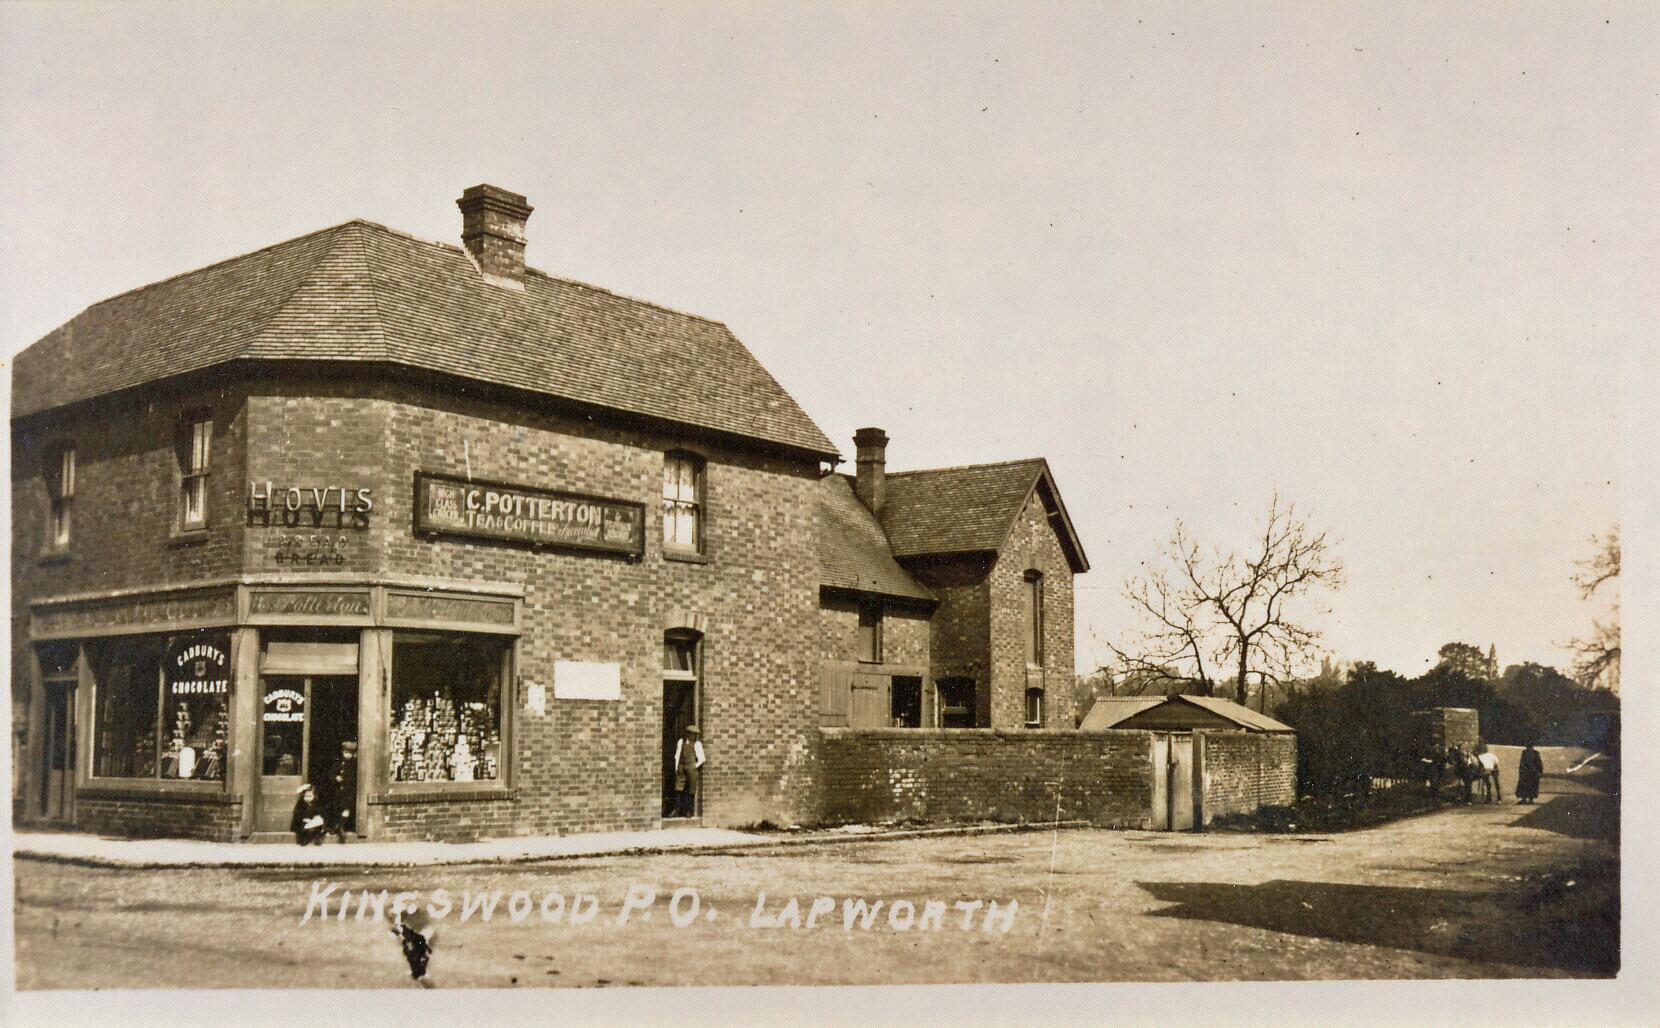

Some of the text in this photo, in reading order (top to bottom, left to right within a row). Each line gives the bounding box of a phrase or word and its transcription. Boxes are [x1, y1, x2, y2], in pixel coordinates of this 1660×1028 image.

[250, 481, 374, 513] HOVIS
[466, 509, 496, 529] TEA
[503, 515, 557, 535] COFFEE
[172, 680, 228, 694] CHOCOLATE
